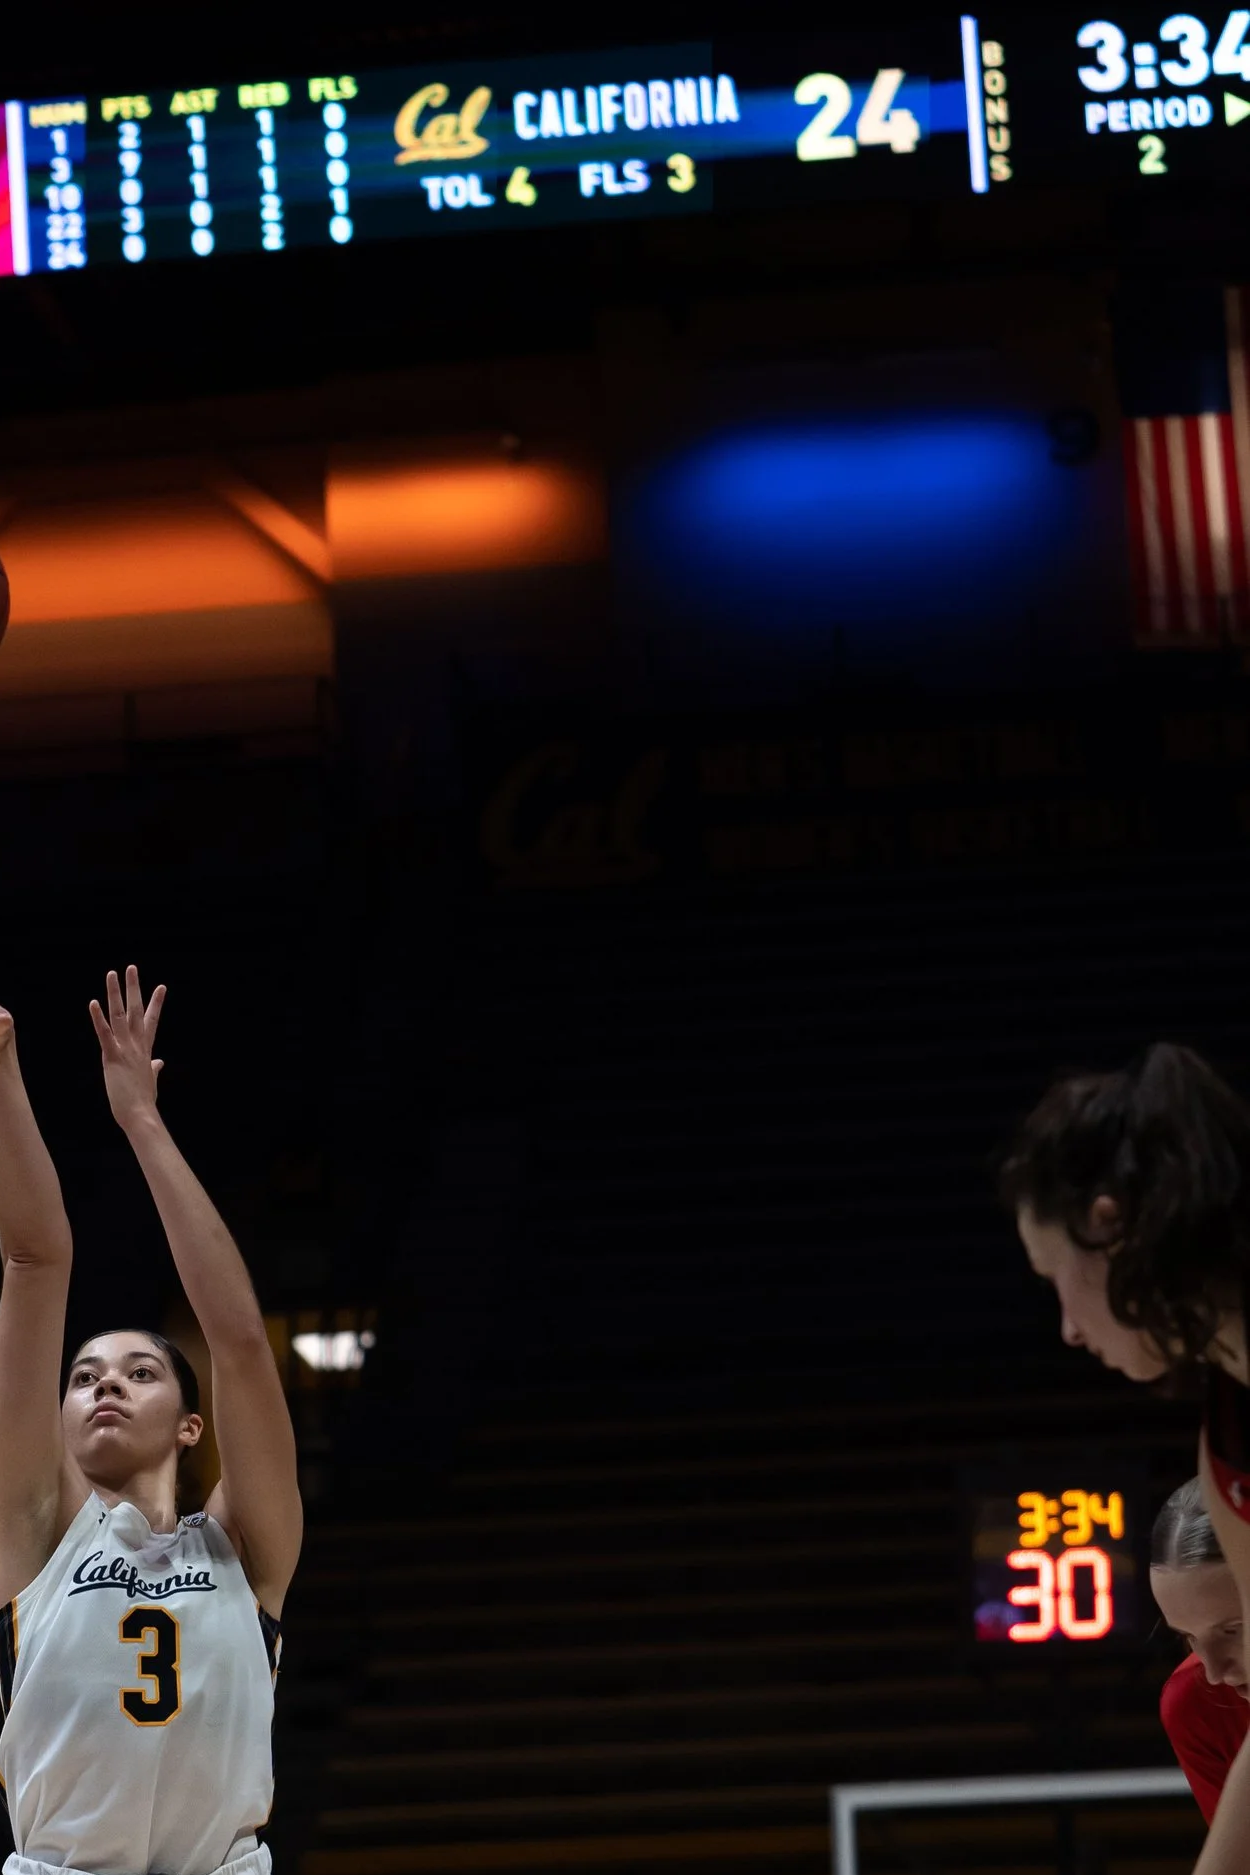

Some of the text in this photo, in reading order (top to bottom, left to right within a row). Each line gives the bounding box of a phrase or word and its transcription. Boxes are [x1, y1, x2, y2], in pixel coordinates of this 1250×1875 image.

[101, 95, 152, 121] PTS
[170, 88, 220, 115] AST
[308, 75, 358, 102] FLS
[394, 82, 492, 166] Cal
[513, 74, 739, 140] CALIFORNIA
[794, 67, 921, 161] 24
[981, 41, 1012, 181] BONUS
[1085, 95, 1212, 134] PERIOD
[50, 128, 68, 156] 1
[187, 114, 206, 143] 1
[255, 108, 274, 136] 1
[322, 102, 346, 130] 0
[1138, 134, 1168, 175] 2
[49, 156, 73, 183] 3
[188, 143, 207, 171] 1
[257, 136, 276, 164] 1
[324, 130, 348, 158] 0
[420, 152, 696, 211] TOL 4 FLS 3
[43, 158, 350, 212] 10 0 1 1 0
[121, 206, 144, 234] 3
[189, 200, 213, 228] 0
[329, 187, 349, 215] 1
[122, 234, 147, 262] 0
[191, 228, 215, 256] 0
[329, 215, 353, 244] 0
[1017, 1489, 1124, 1548] 3:34
[68, 1550, 218, 1600] California
[1007, 1547, 1113, 1643] 30
[118, 1605, 183, 1727] 3
